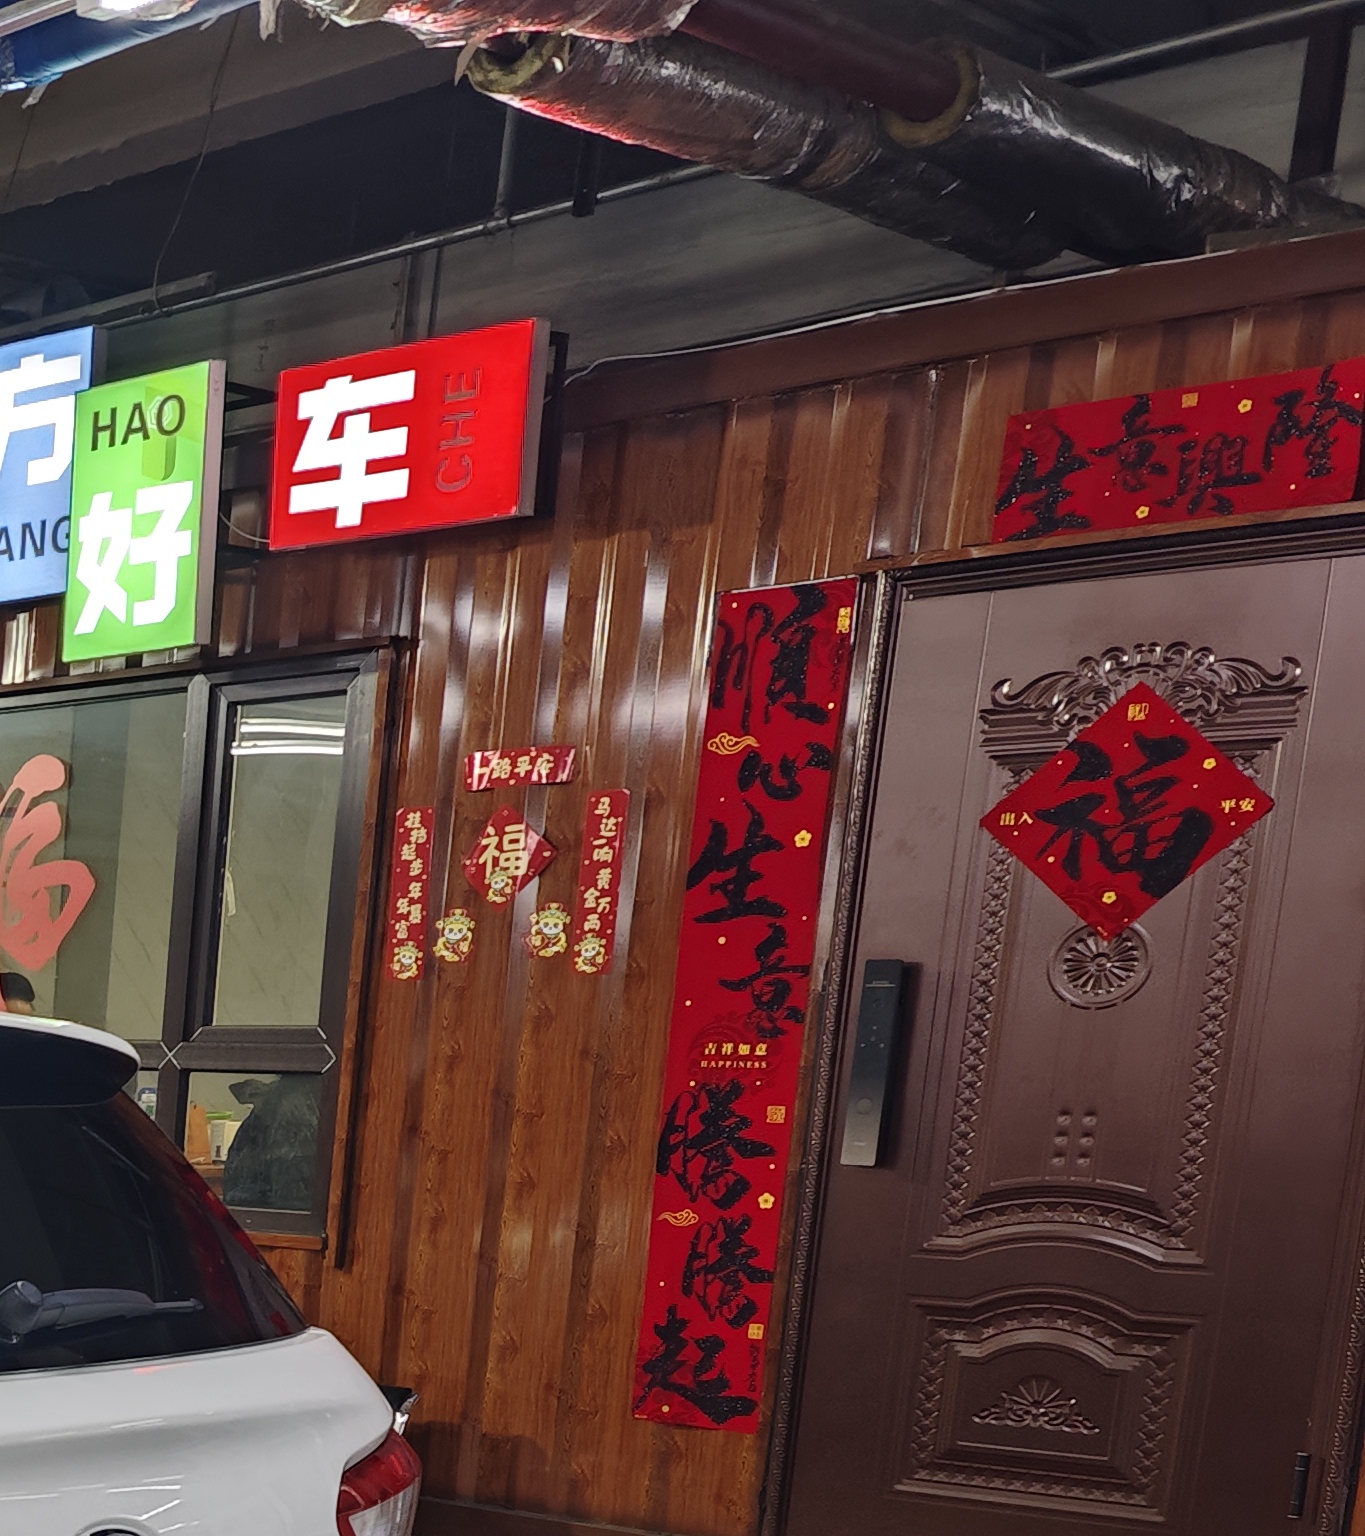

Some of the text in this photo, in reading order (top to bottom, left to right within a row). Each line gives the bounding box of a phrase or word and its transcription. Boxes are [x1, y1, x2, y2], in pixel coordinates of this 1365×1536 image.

[90, 394, 186, 452] HAO
[288, 369, 416, 528] 车
[435, 367, 483, 495] CHE
[73, 480, 193, 636] 好
[478, 824, 530, 878] 福
[1000, 798, 1256, 826] 出入 平安
[1035, 730, 1214, 899] 福
[583, 797, 622, 931] 马达一响黄金万两
[700, 1060, 768, 1069] HAPPINESS
[704, 1042, 768, 1056] 吉祥如意
